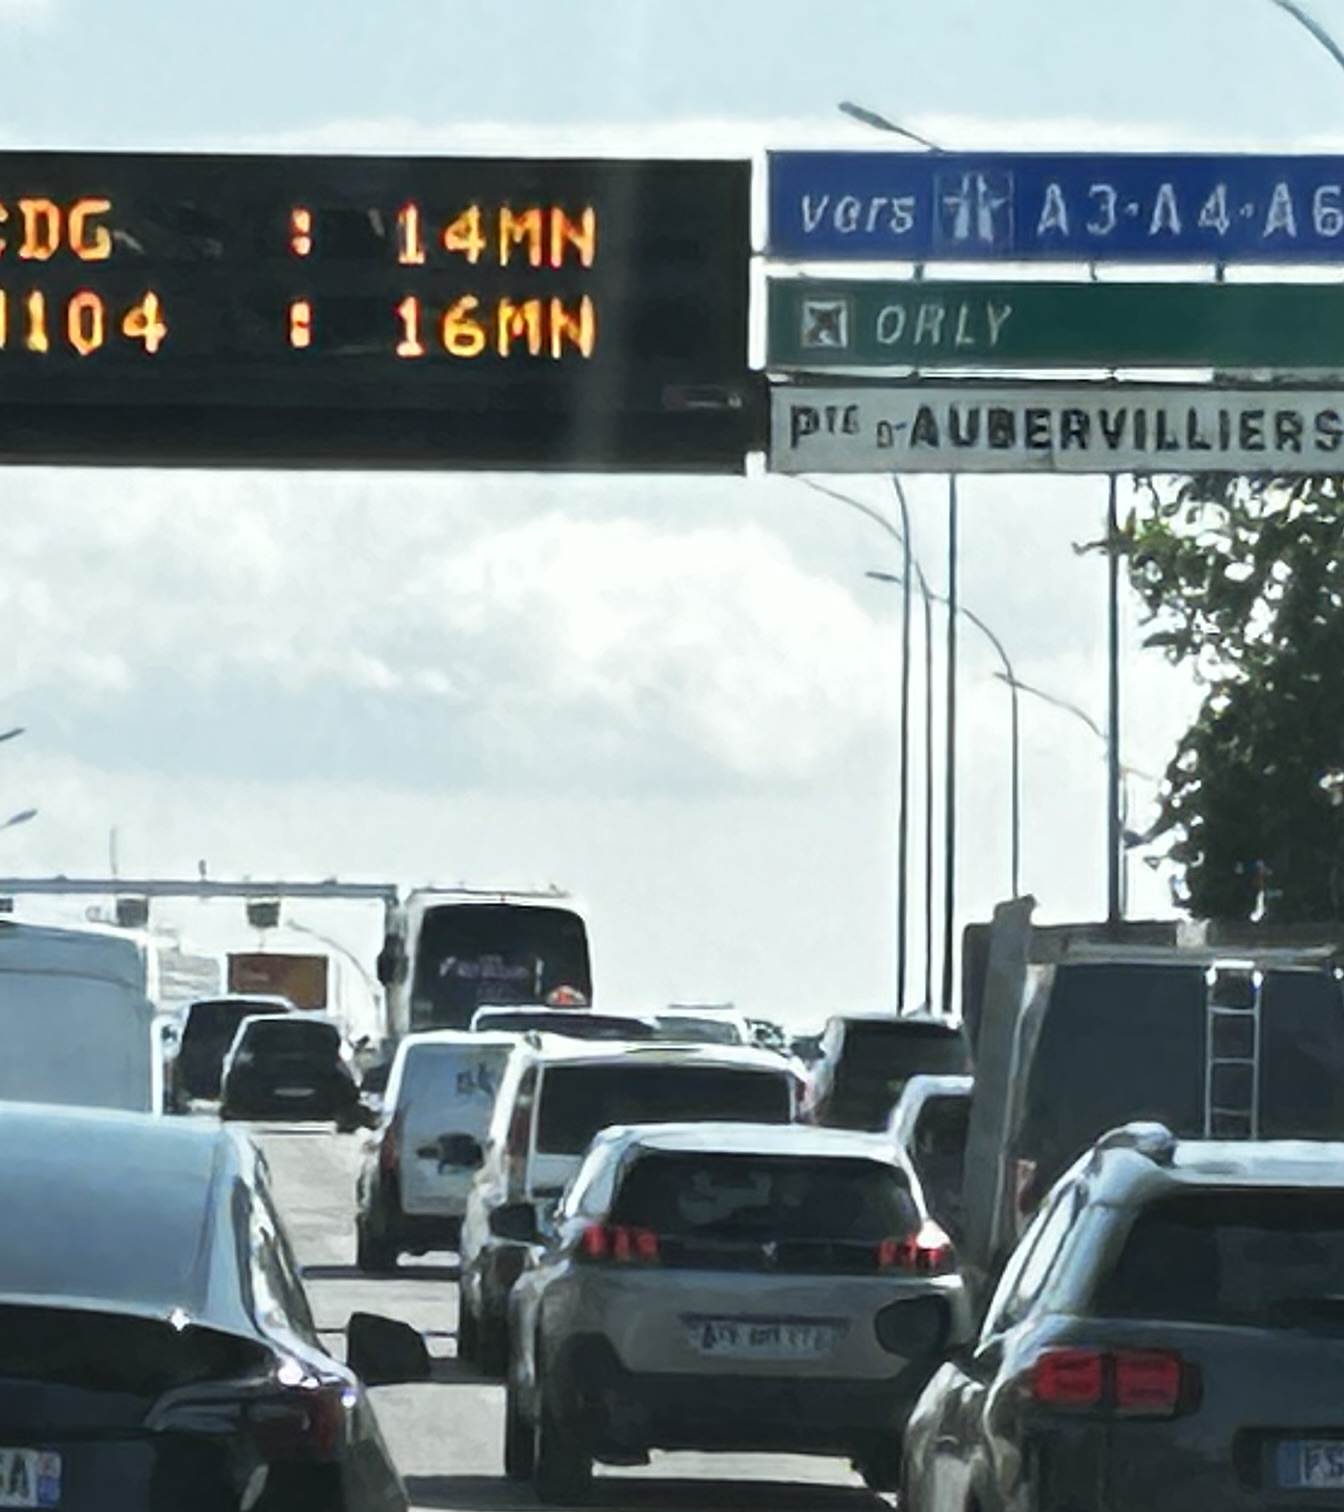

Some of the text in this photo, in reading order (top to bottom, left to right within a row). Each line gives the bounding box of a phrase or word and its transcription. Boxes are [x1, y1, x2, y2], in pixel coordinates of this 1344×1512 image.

[396, 202, 597, 268] 14MN
[801, 194, 918, 233] vers
[395, 295, 597, 359] 16MN
[875, 303, 1013, 347] ORLY
